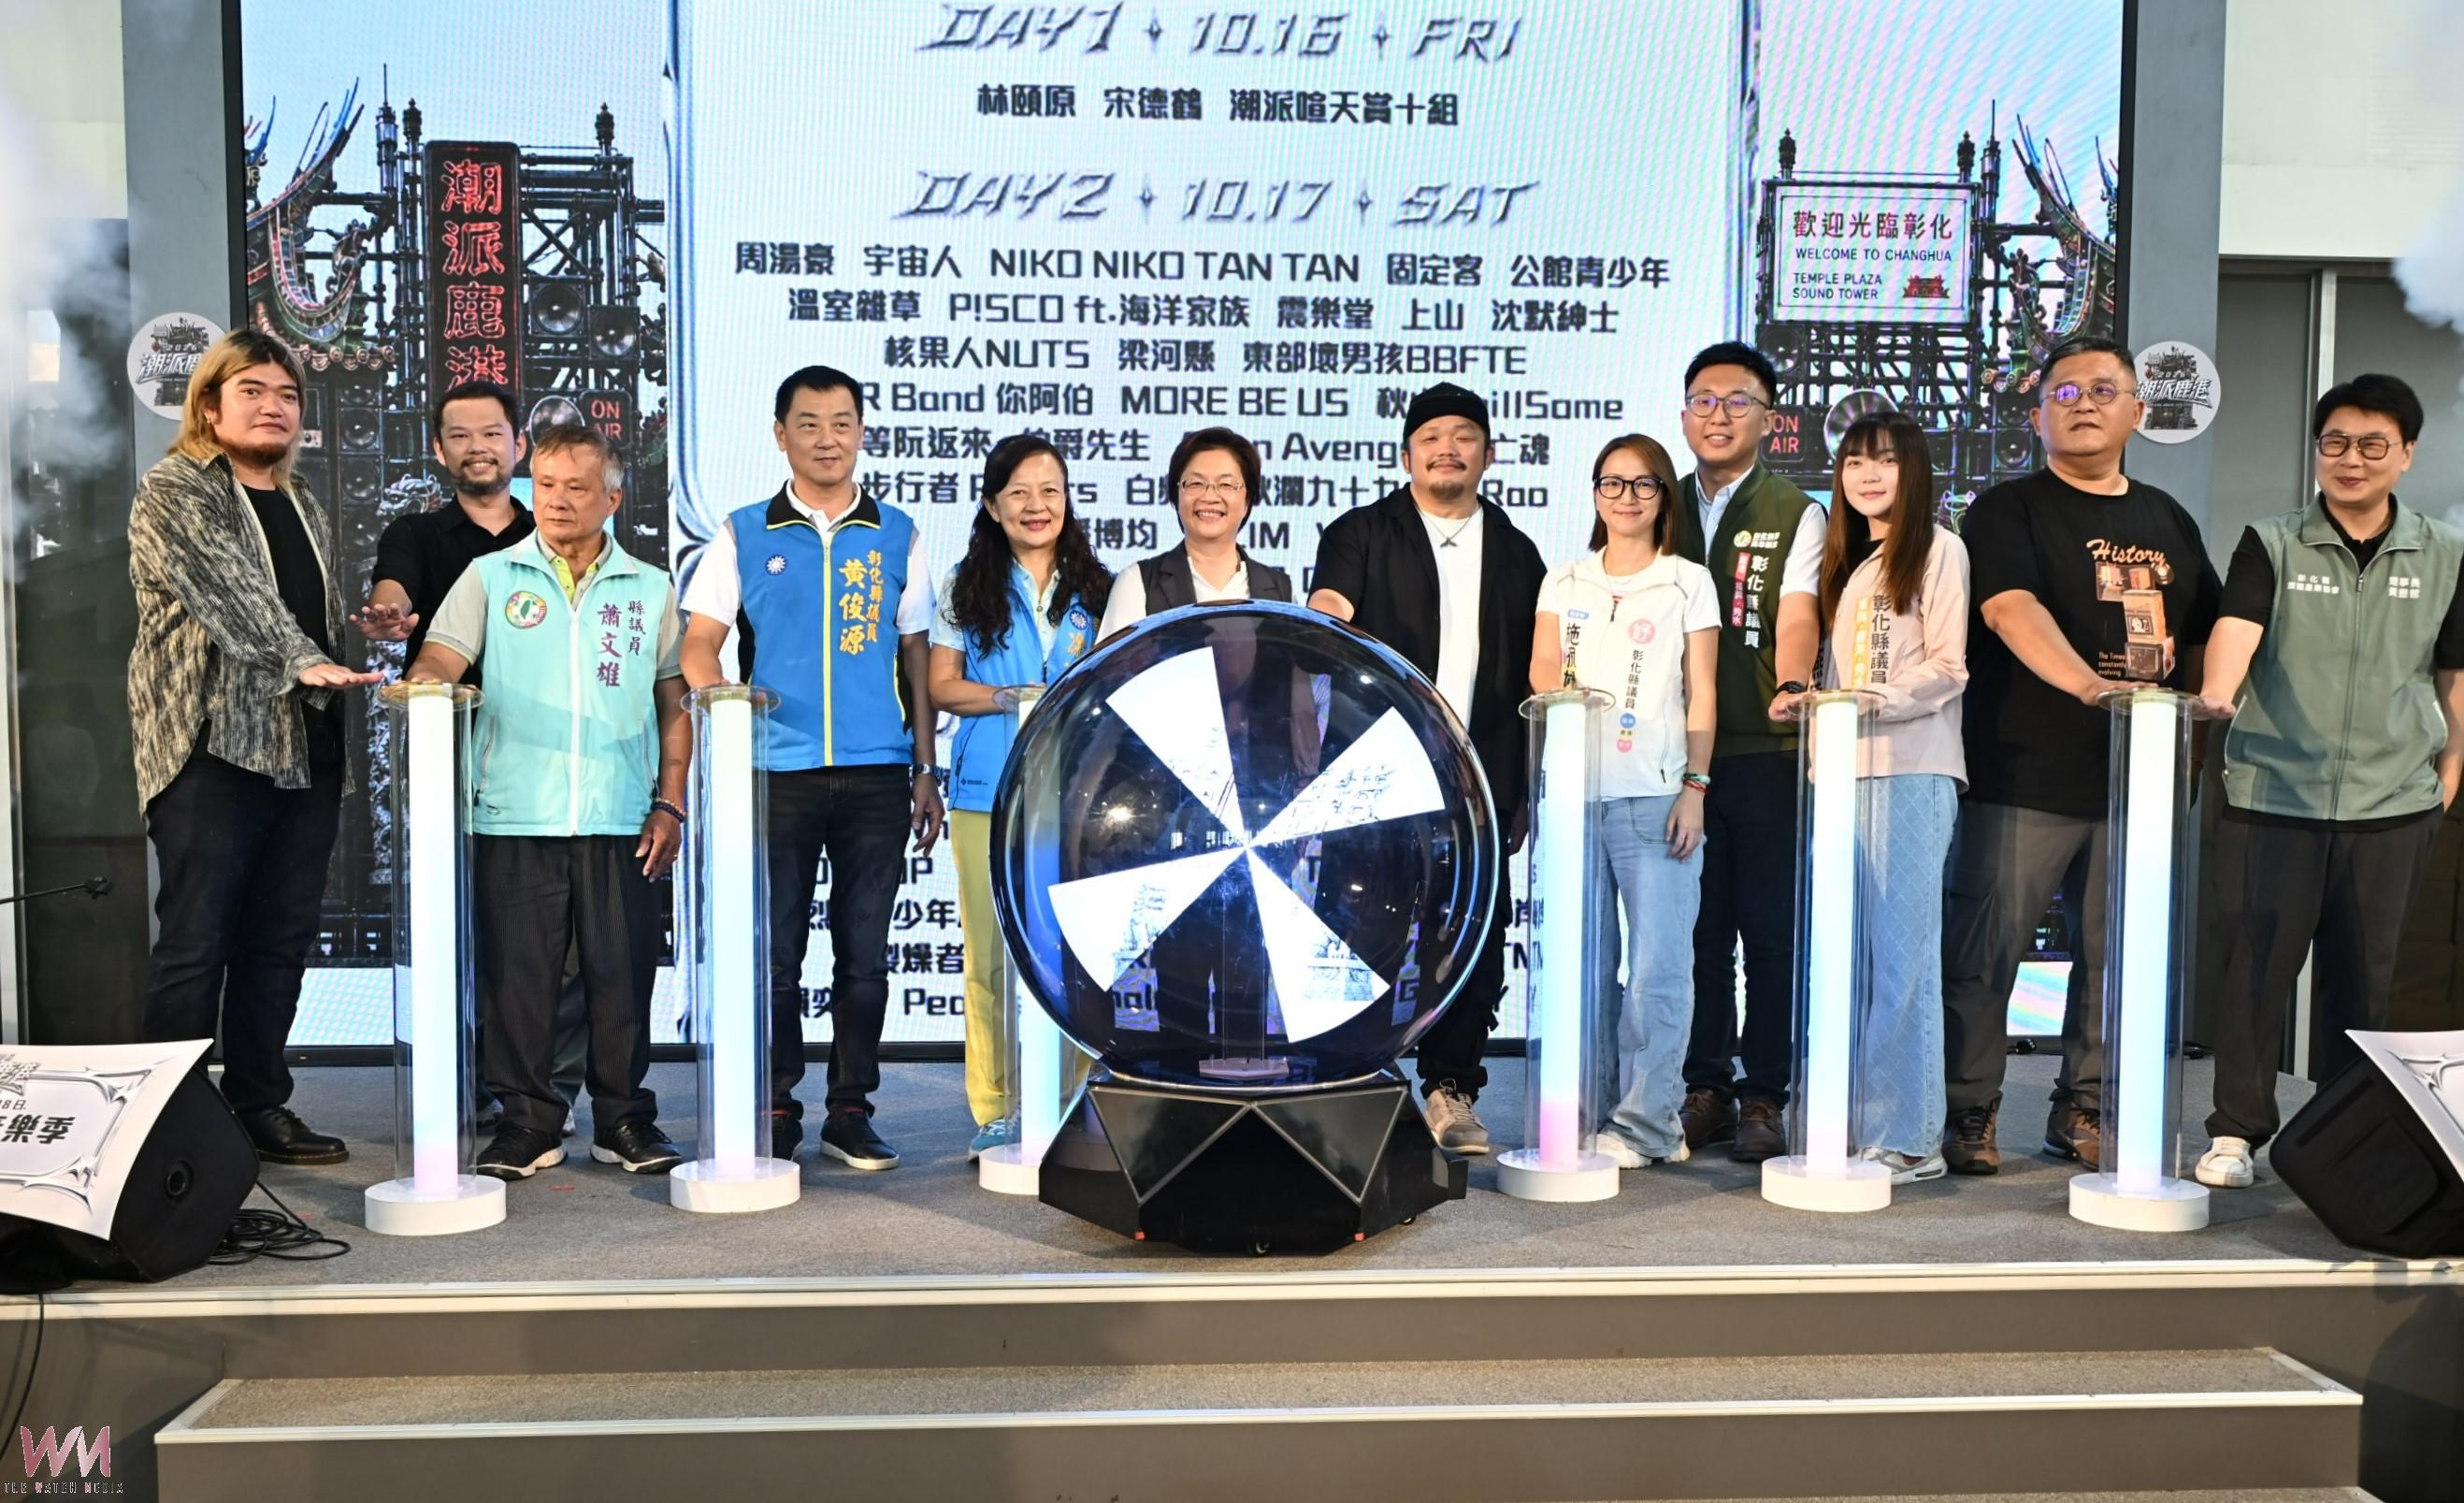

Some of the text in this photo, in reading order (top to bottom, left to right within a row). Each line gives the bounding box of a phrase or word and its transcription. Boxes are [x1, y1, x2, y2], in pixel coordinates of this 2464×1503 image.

[1189, 13, 1349, 58] 10.16
[1410, 16, 1523, 64] FRI
[977, 83, 1076, 118] 林頤原
[1103, 86, 1203, 121] 宋德鶴
[1181, 178, 1333, 223] 10.17
[1391, 181, 1541, 226] SAT
[1793, 210, 1952, 240] 歡迎光臨彰化
[735, 241, 1669, 289] 周湯豪 宇宙人 NIKO NIKO TAN TAN 固定客 公館青少年
[1795, 248, 1952, 262] WELCOME TO CHANGHUA
[1793, 287, 1879, 299] SOUND TOWER
[1794, 272, 1882, 285] TEMPLE PLAZA
[788, 288, 921, 322] 溫室雜草
[1277, 296, 1374, 329] 震樂堂
[1402, 298, 1463, 331] 上山
[884, 336, 1089, 369] 核果人NUTS
[591, 399, 620, 419] ON
[891, 383, 985, 412] Band
[996, 383, 1093, 416] 你阿伯
[1121, 385, 1228, 416] MORE
[1238, 386, 1287, 416] BE
[1297, 387, 1348, 417] US
[1484, 390, 1623, 420] illSome
[1773, 414, 1798, 433] ON
[1282, 432, 1404, 468] Aveng
[1770, 436, 1799, 454] AIR
[863, 470, 958, 504] 步行者
[1078, 517, 1158, 550] 博均
[2086, 539, 2166, 565] History
[838, 558, 868, 656] 黃俊源
[1744, 555, 1769, 649] 彰化縣議員
[597, 602, 623, 687] 蕭文雄
[627, 600, 646, 656] 縣議員
[1870, 594, 1893, 685] 彰化縣議員
[1624, 649, 1644, 710] 彰化縣議員
[893, 899, 963, 930] 少年
